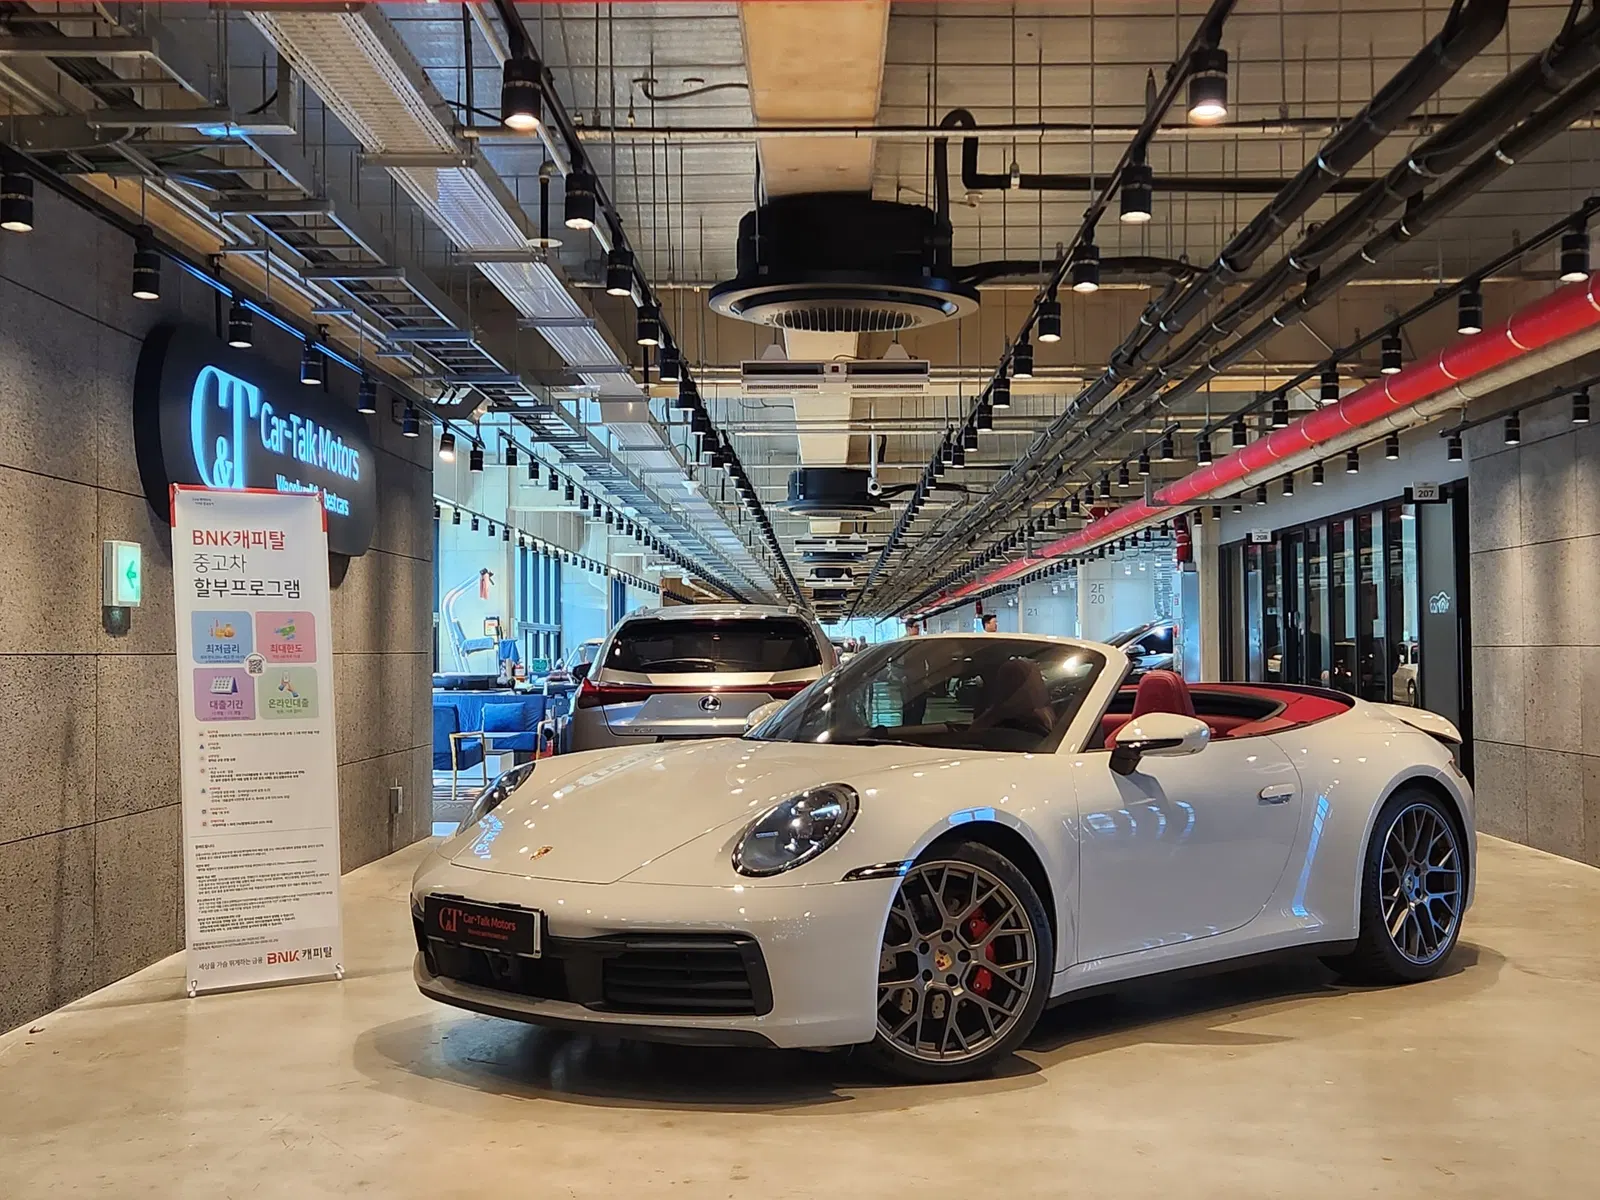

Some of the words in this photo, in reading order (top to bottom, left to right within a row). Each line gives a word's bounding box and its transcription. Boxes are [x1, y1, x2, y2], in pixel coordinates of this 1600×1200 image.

[261, 402, 317, 466] Car-Talk
[319, 425, 360, 481] Motors
[1418, 489, 1434, 498] 207
[192, 529, 286, 550] BNK캐피탈
[193, 553, 248, 573] 중고차
[194, 577, 301, 599] 할부프로그램
[1090, 583, 1105, 594] 2F
[1090, 594, 1105, 604] 20
[1027, 608, 1039, 617] 21
[206, 644, 240, 654] 최저금리
[270, 644, 304, 654] 최대한도
[209, 699, 244, 710] 대출기간
[268, 699, 309, 709] 온라인대출
[491, 918, 516, 931] Motors
[198, 962, 216, 971] 세상을
[216, 960, 228, 968] 가슴
[267, 950, 300, 965] BNK
[302, 946, 332, 960] 캐피탈
